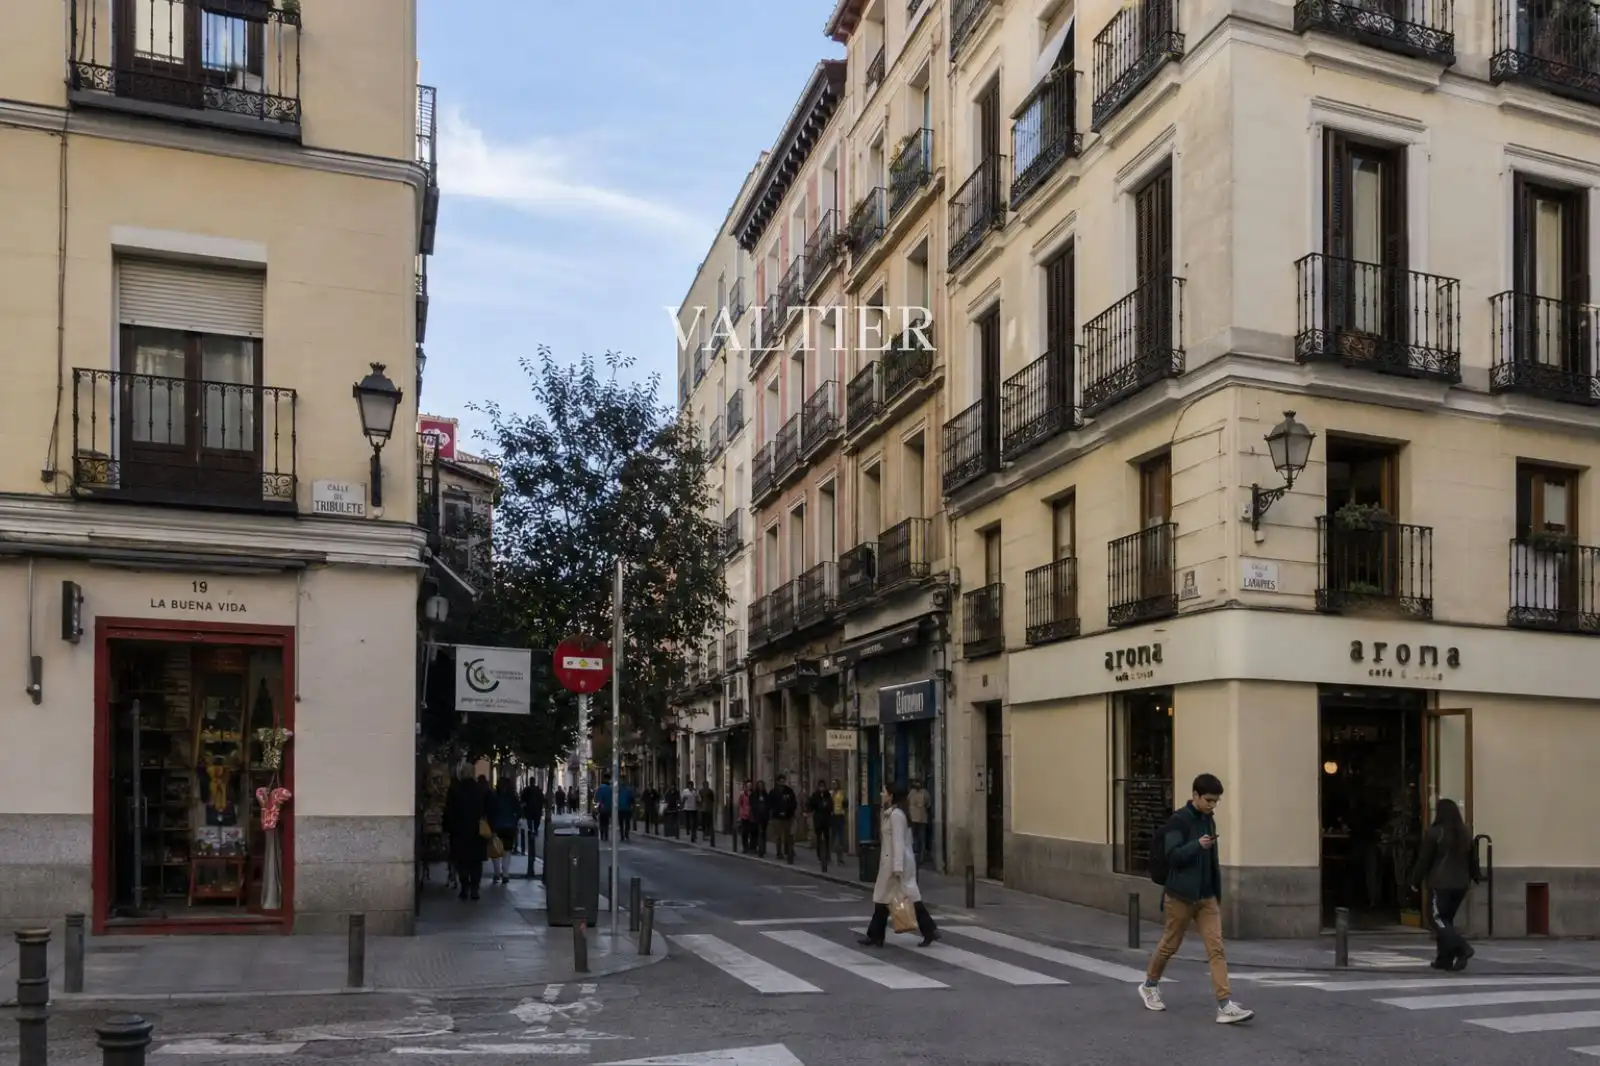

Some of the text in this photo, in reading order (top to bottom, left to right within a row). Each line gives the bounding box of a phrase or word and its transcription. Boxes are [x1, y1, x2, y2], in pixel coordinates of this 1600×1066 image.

[315, 500, 363, 514] TRIBULETE
[192, 580, 208, 593] 19
[150, 598, 247, 612] LA BUENA VIDA
[1105, 643, 1163, 671] arona
[1350, 640, 1460, 669] arona
